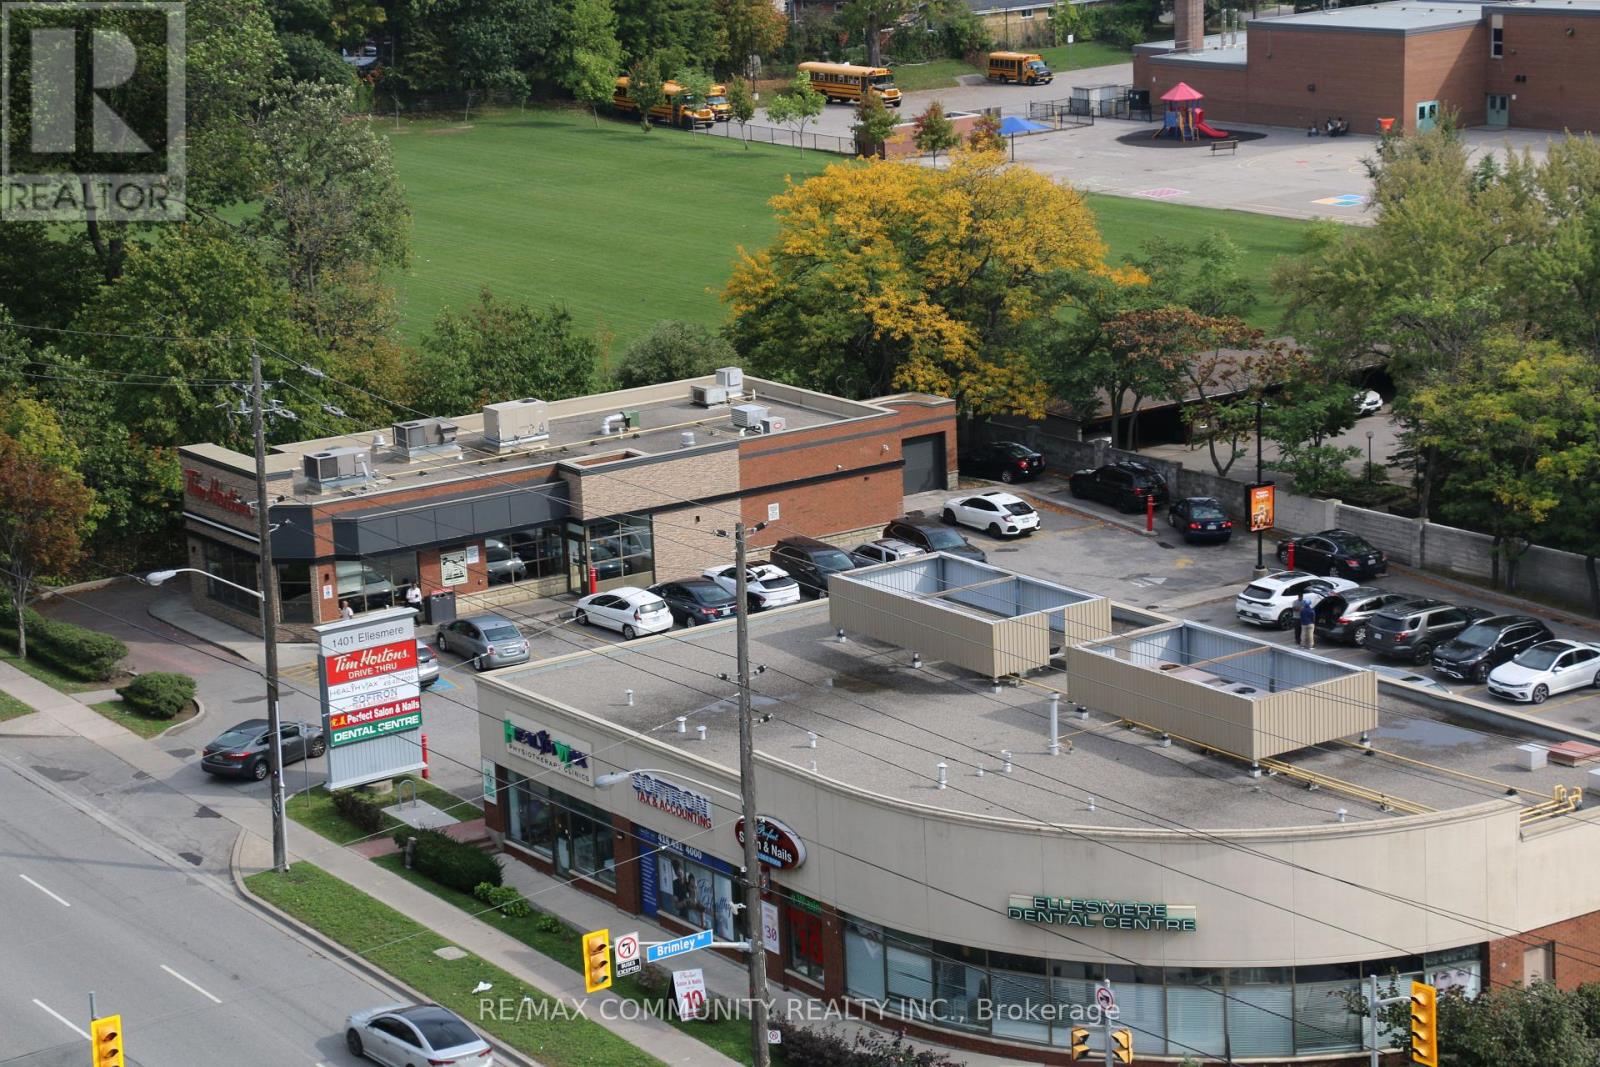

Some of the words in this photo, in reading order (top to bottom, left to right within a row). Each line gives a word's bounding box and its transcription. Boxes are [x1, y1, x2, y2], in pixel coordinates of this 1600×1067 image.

[332, 636, 354, 648] 1401
[358, 626, 404, 643] Ellesmere
[334, 653, 359, 673] Tim
[360, 648, 407, 667] Hortons
[348, 667, 373, 679] DRIVE
[375, 662, 397, 673] THRU
[347, 708, 373, 724] Perfect
[374, 706, 394, 718] Salon
[395, 703, 401, 713] &
[402, 699, 420, 712] Nails
[334, 725, 376, 742] DENTAL
[377, 715, 419, 732] CENTRE
[564, 767, 590, 782] CLINICS
[636, 790, 651, 806] TAX
[652, 798, 658, 808] &
[659, 799, 712, 830] ACCOUNTING
[763, 841, 769, 853] &
[771, 845, 793, 864] Nails
[1033, 896, 1168, 918] ELLESMERE
[1008, 907, 1097, 928] DENTAL
[1102, 917, 1196, 932] CENTRE
[657, 939, 695, 957] Brimley
